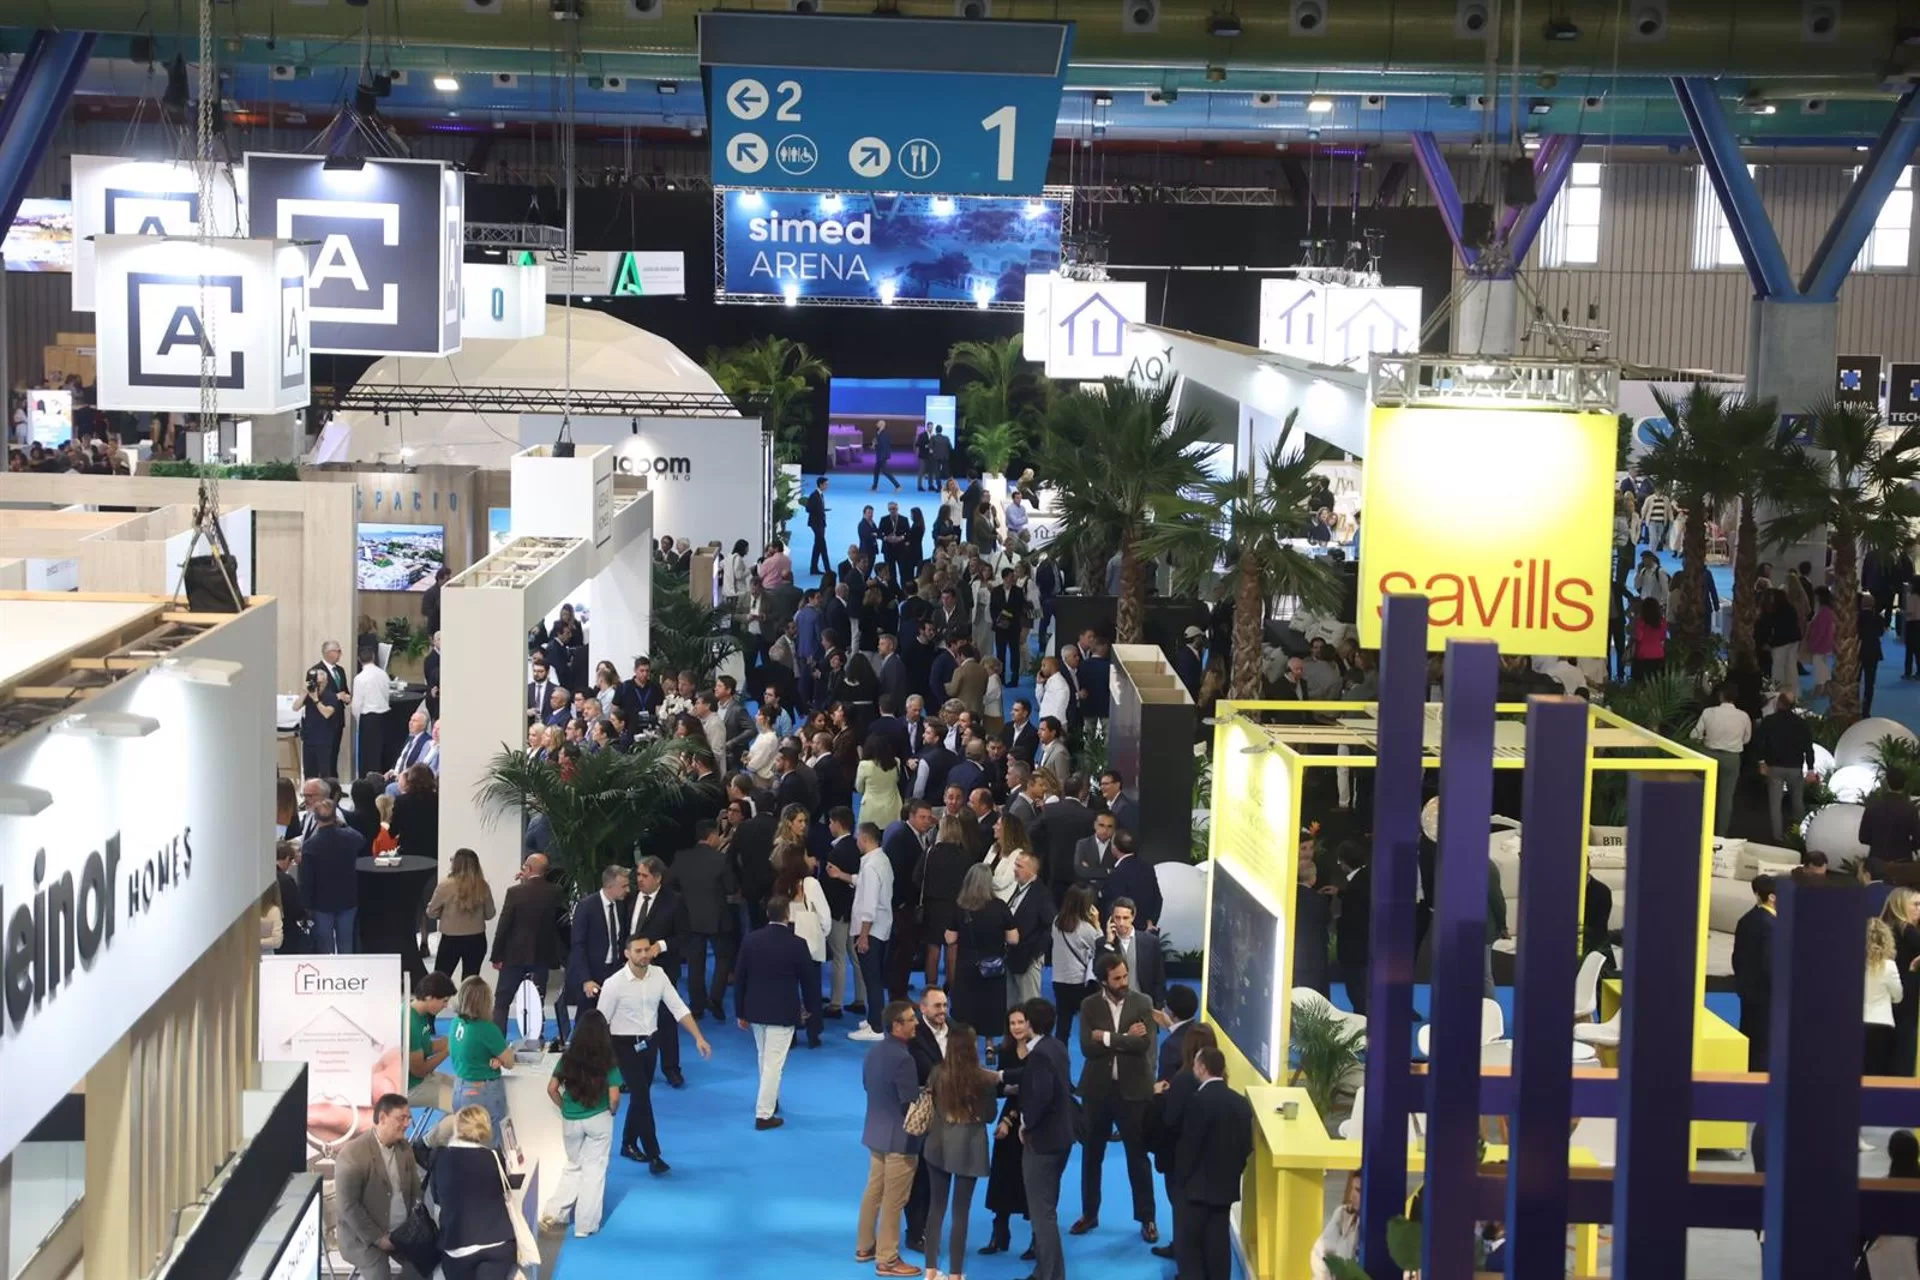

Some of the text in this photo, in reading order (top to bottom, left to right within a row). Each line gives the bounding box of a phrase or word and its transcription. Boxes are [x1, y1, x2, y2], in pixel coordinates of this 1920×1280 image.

[775, 80, 802, 121] 2
[981, 105, 1017, 181] 1
[749, 210, 872, 244] simed
[750, 250, 870, 281] ARENA
[1128, 356, 1163, 381] AQ
[1376, 558, 1594, 632] savills
[0, 826, 192, 1036] einor HOMES
[303, 974, 369, 991] Finaer
